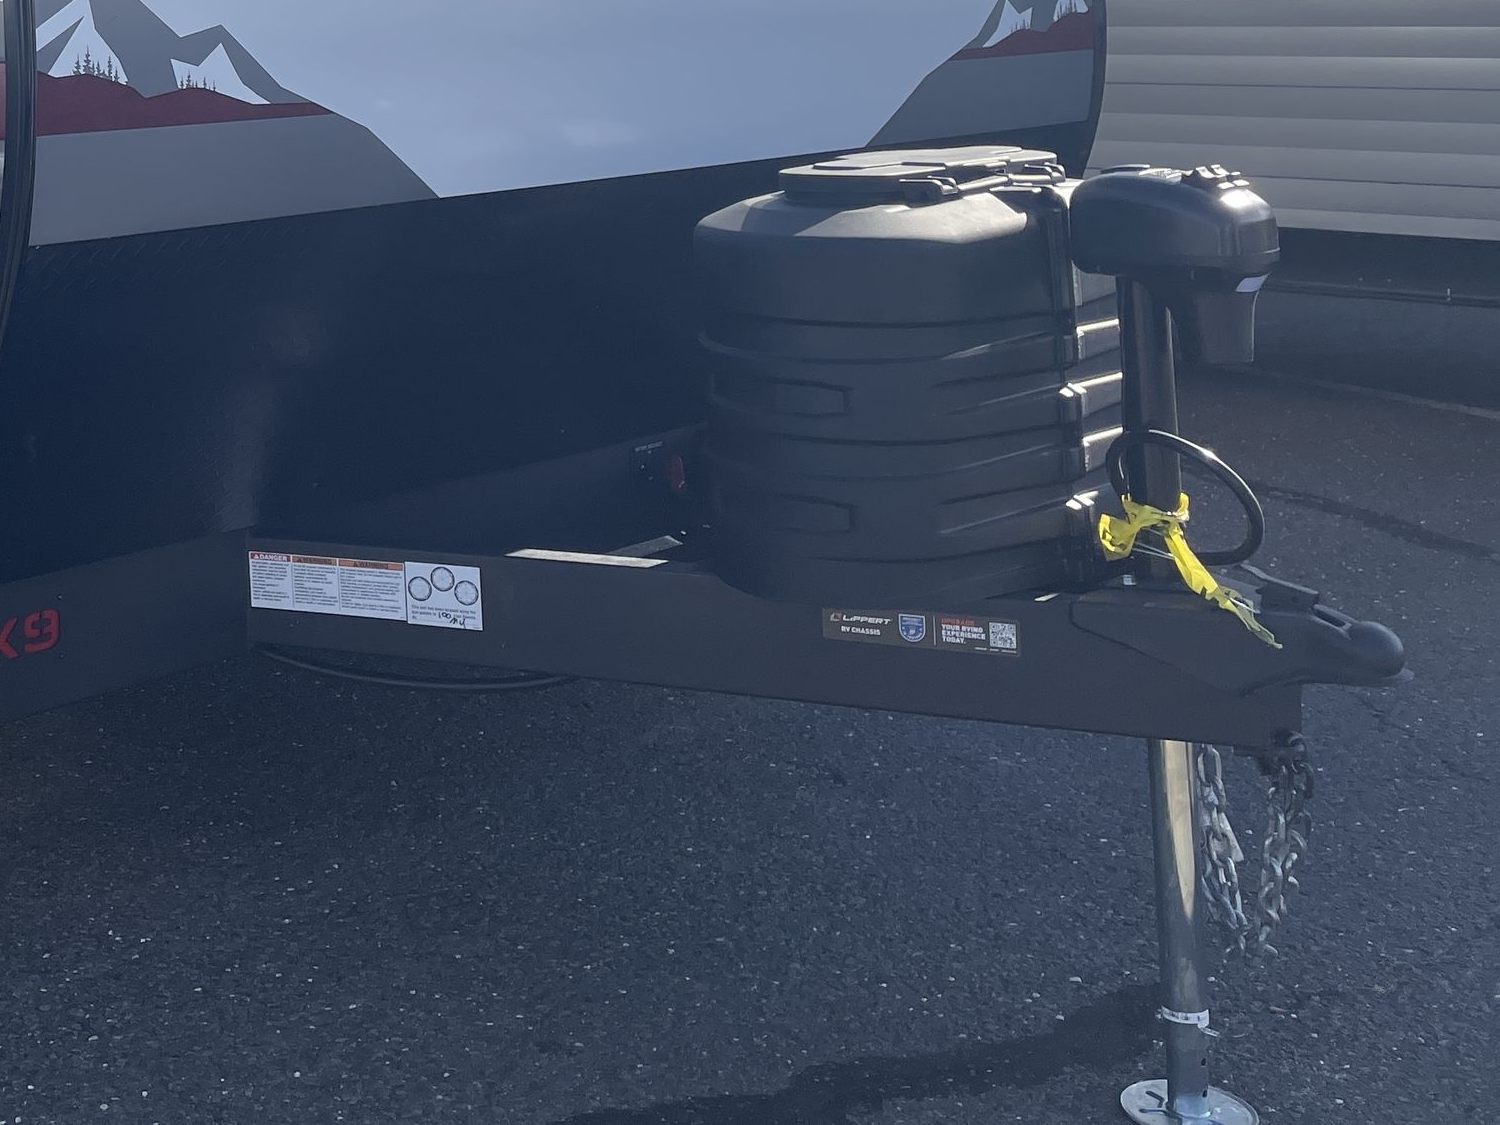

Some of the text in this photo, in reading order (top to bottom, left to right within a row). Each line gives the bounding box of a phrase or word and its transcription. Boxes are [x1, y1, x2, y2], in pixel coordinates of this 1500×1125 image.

[259, 554, 288, 562] DANGER
[842, 614, 892, 625] LIPPERT
[851, 626, 881, 636] CHASSIS
[941, 630, 986, 640] EXPERIENCE
[942, 636, 966, 644] TODAY.
